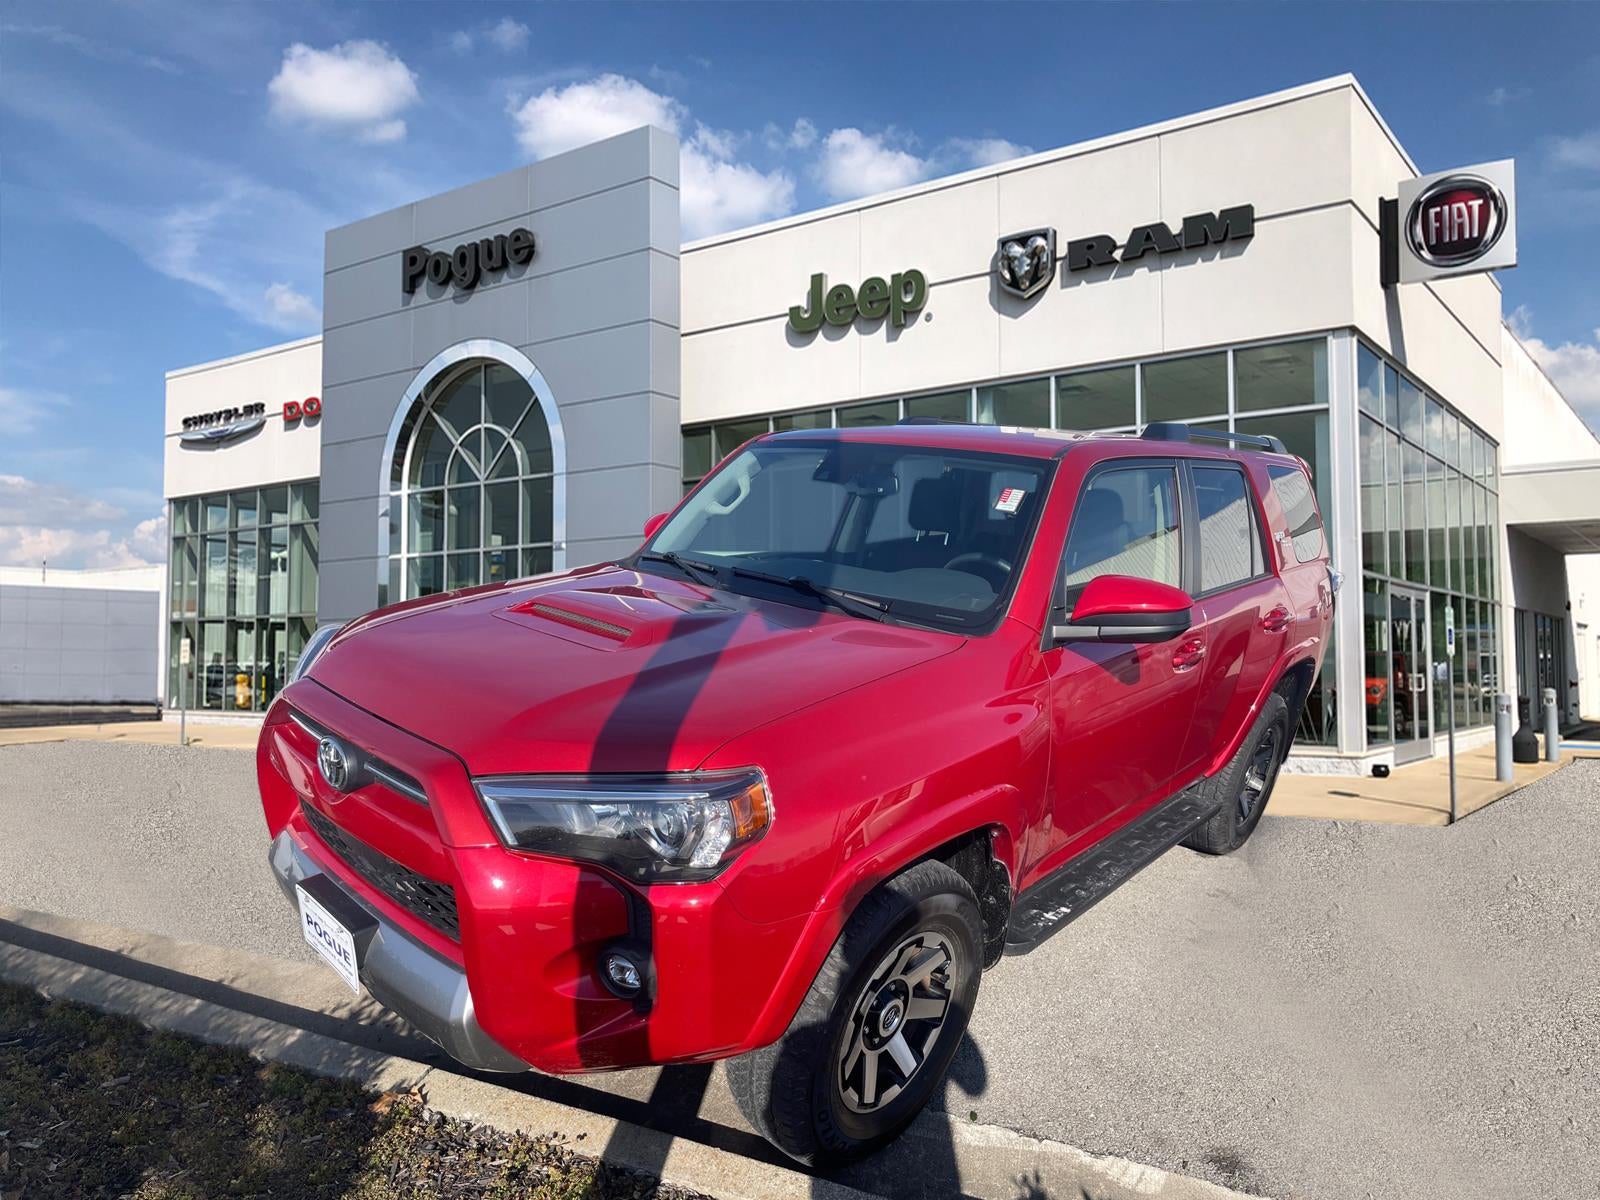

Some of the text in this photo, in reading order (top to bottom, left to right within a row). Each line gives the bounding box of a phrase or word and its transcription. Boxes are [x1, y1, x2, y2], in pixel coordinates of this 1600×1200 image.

[1067, 203, 1254, 272] RAM
[1428, 199, 1483, 246] FIAT
[402, 227, 535, 294] Pogue
[788, 269, 928, 333] Jeep
[182, 402, 265, 428] CHRYSLER
[306, 912, 352, 968] POGUE
